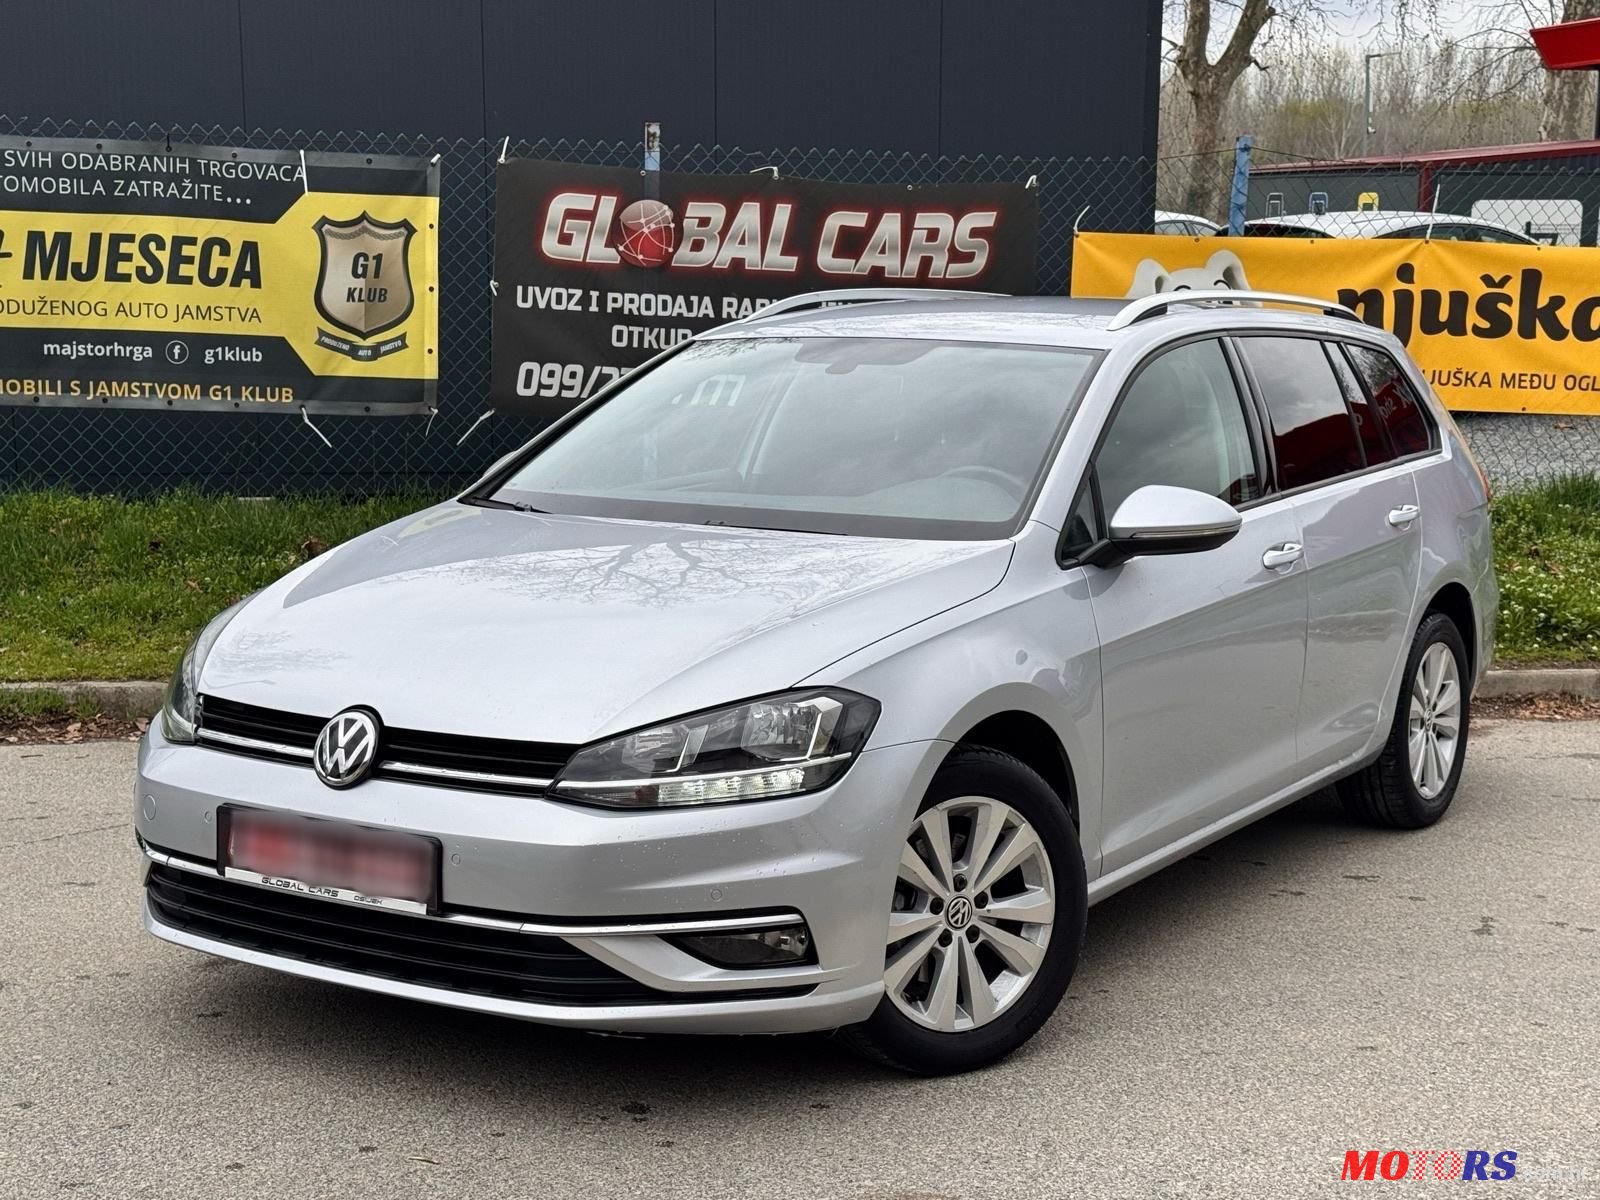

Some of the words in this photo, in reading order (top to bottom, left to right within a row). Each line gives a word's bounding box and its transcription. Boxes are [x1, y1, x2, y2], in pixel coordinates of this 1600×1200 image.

[4, 150, 52, 168] SVIH
[61, 152, 190, 174] ODABRANIH
[197, 159, 306, 182] TRGOVACA
[113, 178, 251, 205] ZATRAŽITE...
[541, 192, 799, 272] GLOBAL
[816, 210, 998, 279] CARS
[22, 230, 262, 289] MJESECA
[351, 252, 383, 279] G1
[346, 287, 387, 303] KLUB
[516, 285, 582, 311] UVOZ
[588, 290, 599, 312] I
[606, 292, 715, 318] PRODAJA
[115, 302, 168, 319] AUTO
[173, 303, 262, 323] JAMSTVA
[43, 341, 153, 361] majstorhrga
[204, 346, 263, 364] g1klub
[70, 380, 81, 396] S
[86, 380, 201, 400] JAMSTVOM
[208, 385, 232, 401] G1
[241, 386, 294, 403] KLUB
[1422, 367, 1492, 389] JUŠKA
[1500, 372, 1557, 391] MEĐU
[261, 876, 304, 892] GLOBAL
[308, 886, 340, 898] CARS
